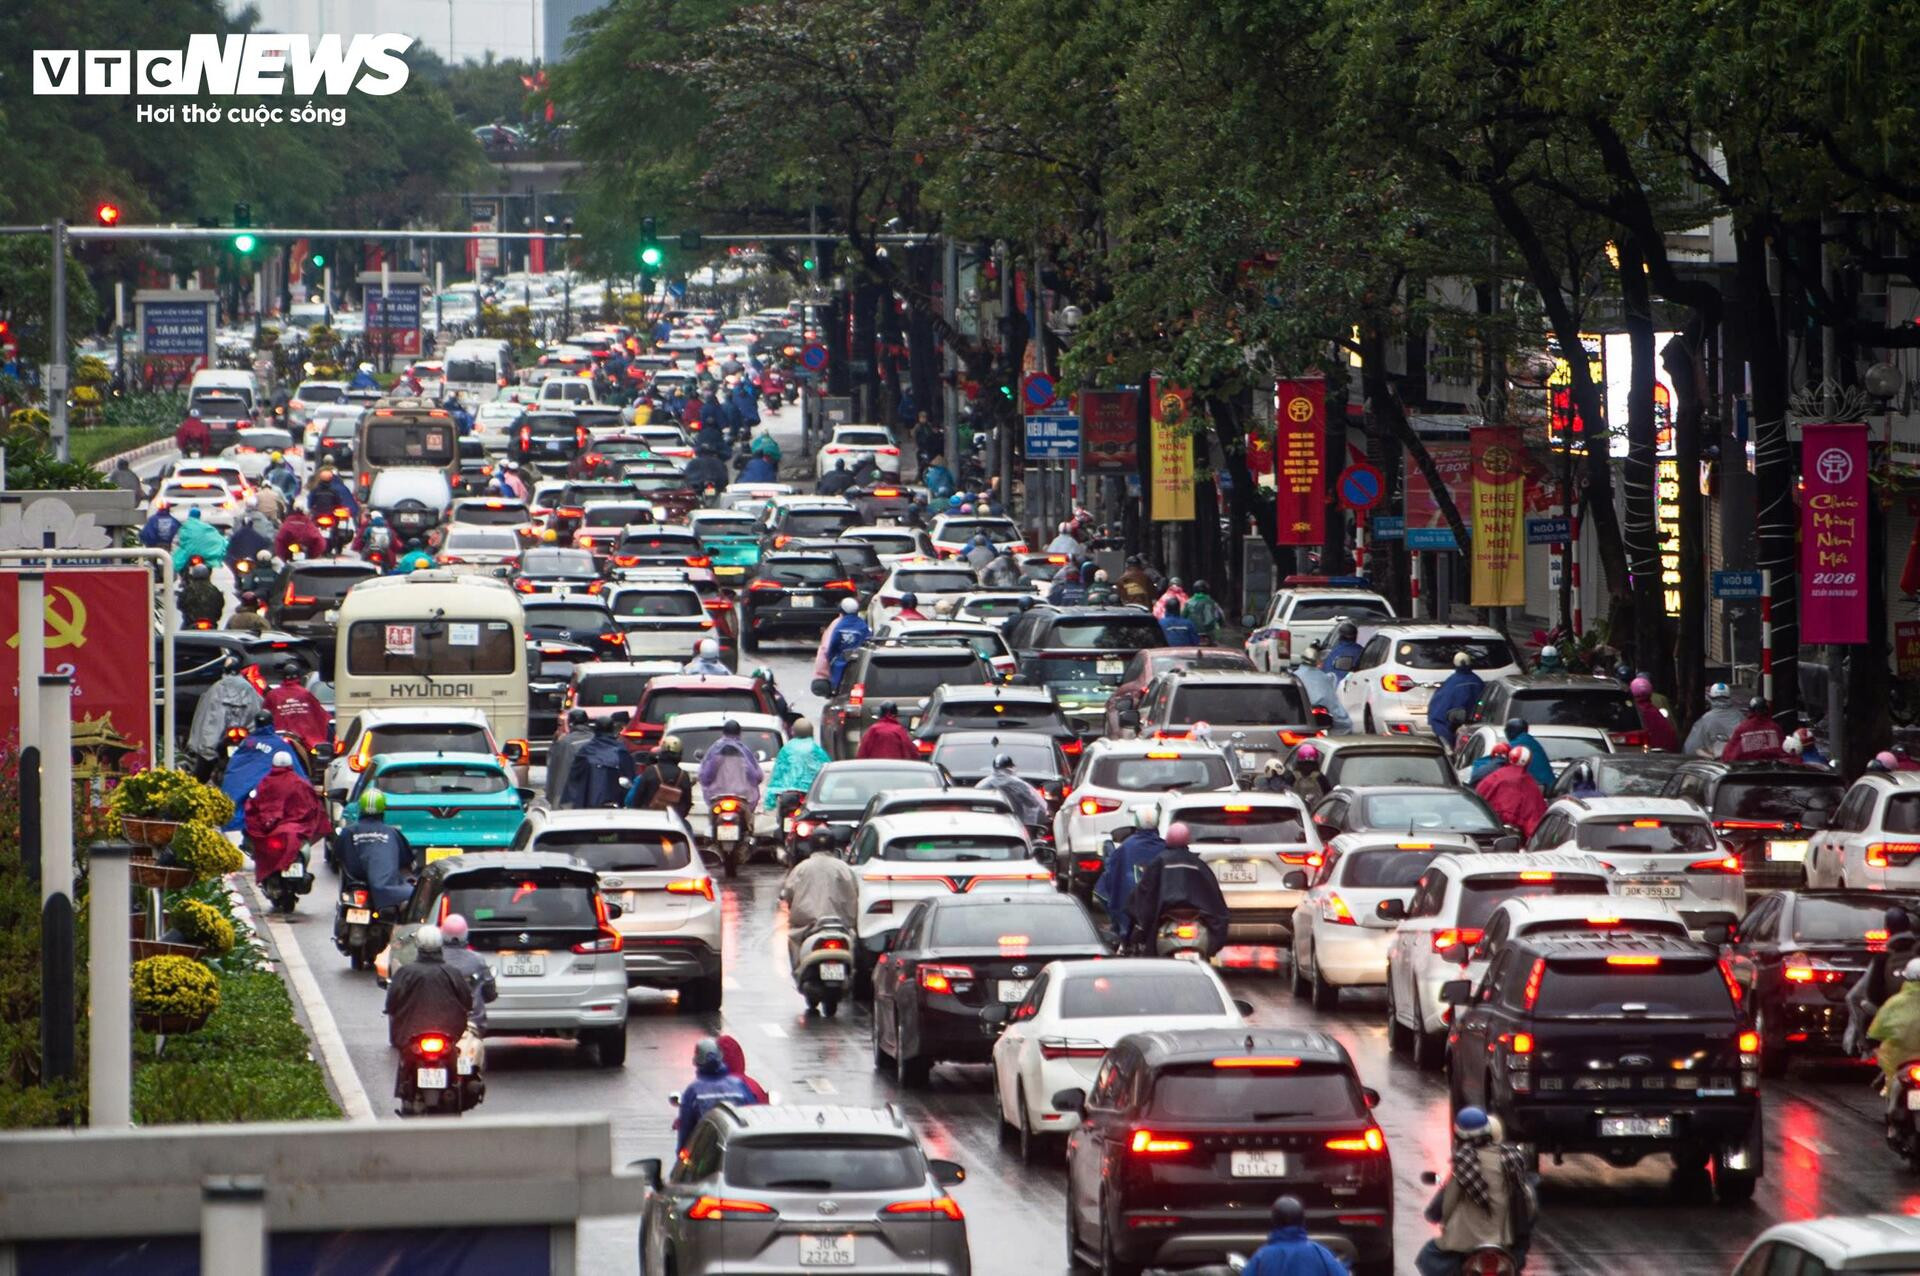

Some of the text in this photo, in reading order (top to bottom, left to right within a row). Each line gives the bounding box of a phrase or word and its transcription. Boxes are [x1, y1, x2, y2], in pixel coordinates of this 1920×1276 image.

[156, 325, 204, 335] TÂM ANH
[1812, 572, 1856, 585] 2026
[391, 684, 473, 697] HYUNDAI
[816, 1236, 838, 1250] 30K
[806, 1251, 849, 1264] 232.05
